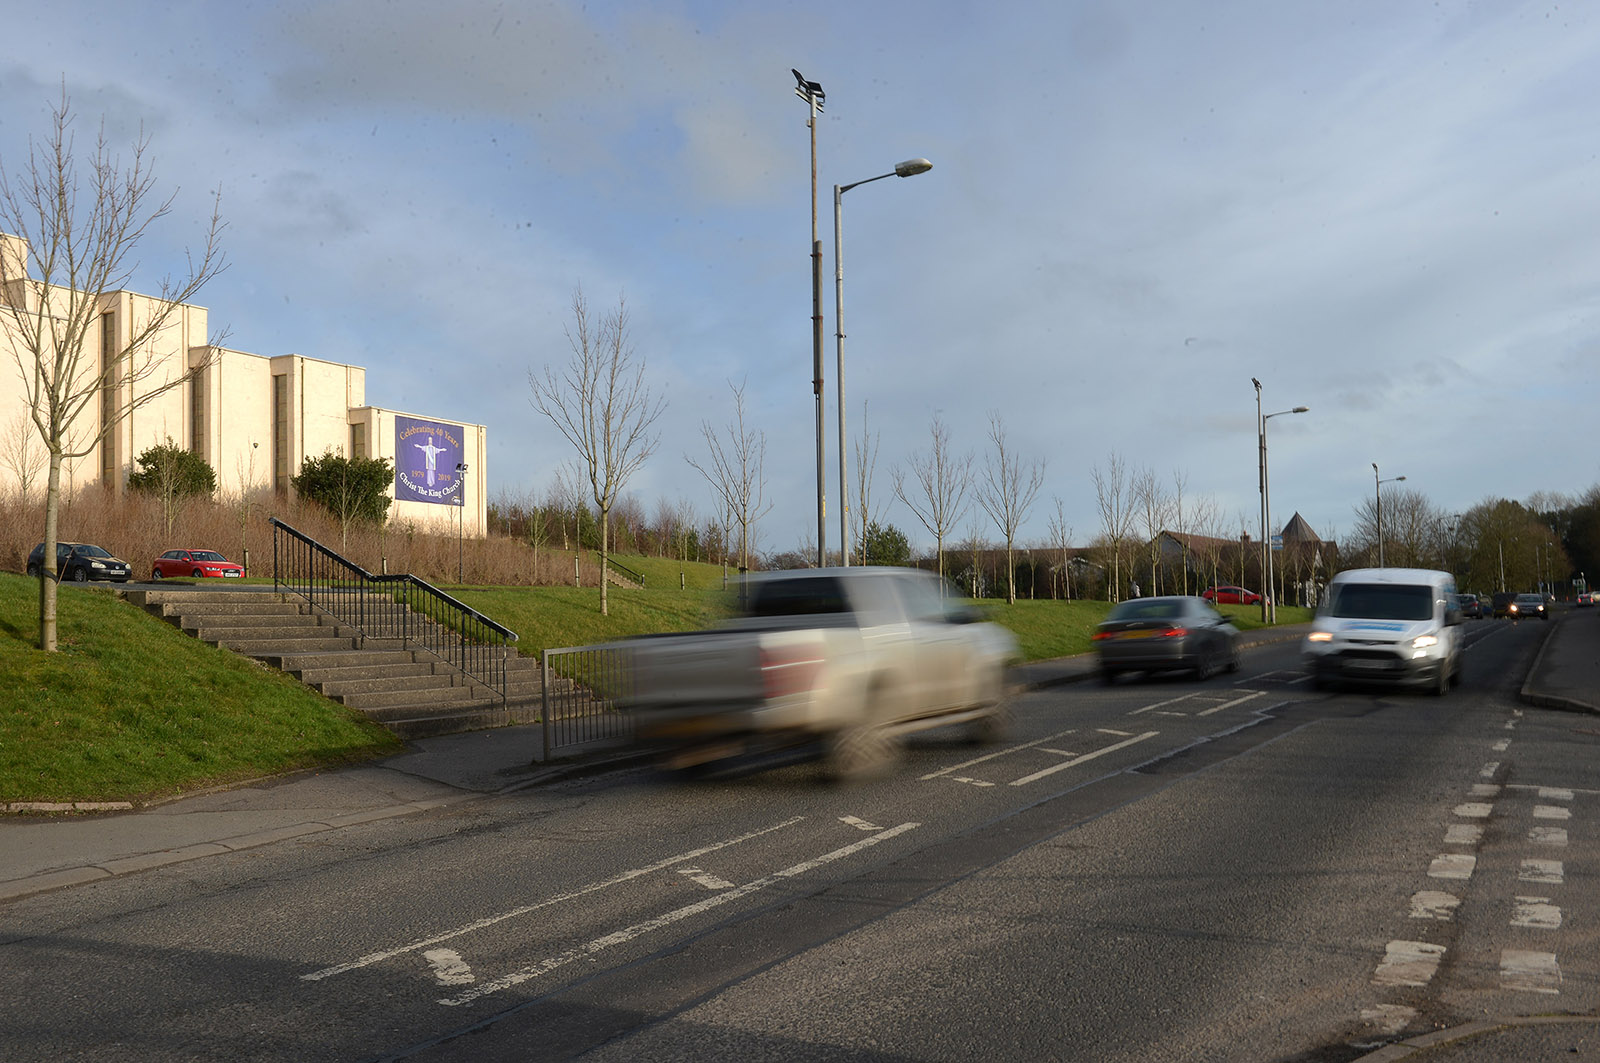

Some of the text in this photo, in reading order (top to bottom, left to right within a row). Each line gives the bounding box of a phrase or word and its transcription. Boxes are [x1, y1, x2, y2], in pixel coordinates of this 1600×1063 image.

[400, 425, 459, 448] Celebrating 40 Years
[400, 472, 461, 498] Christ The King Church
[411, 470, 451, 481] 1979 2019
